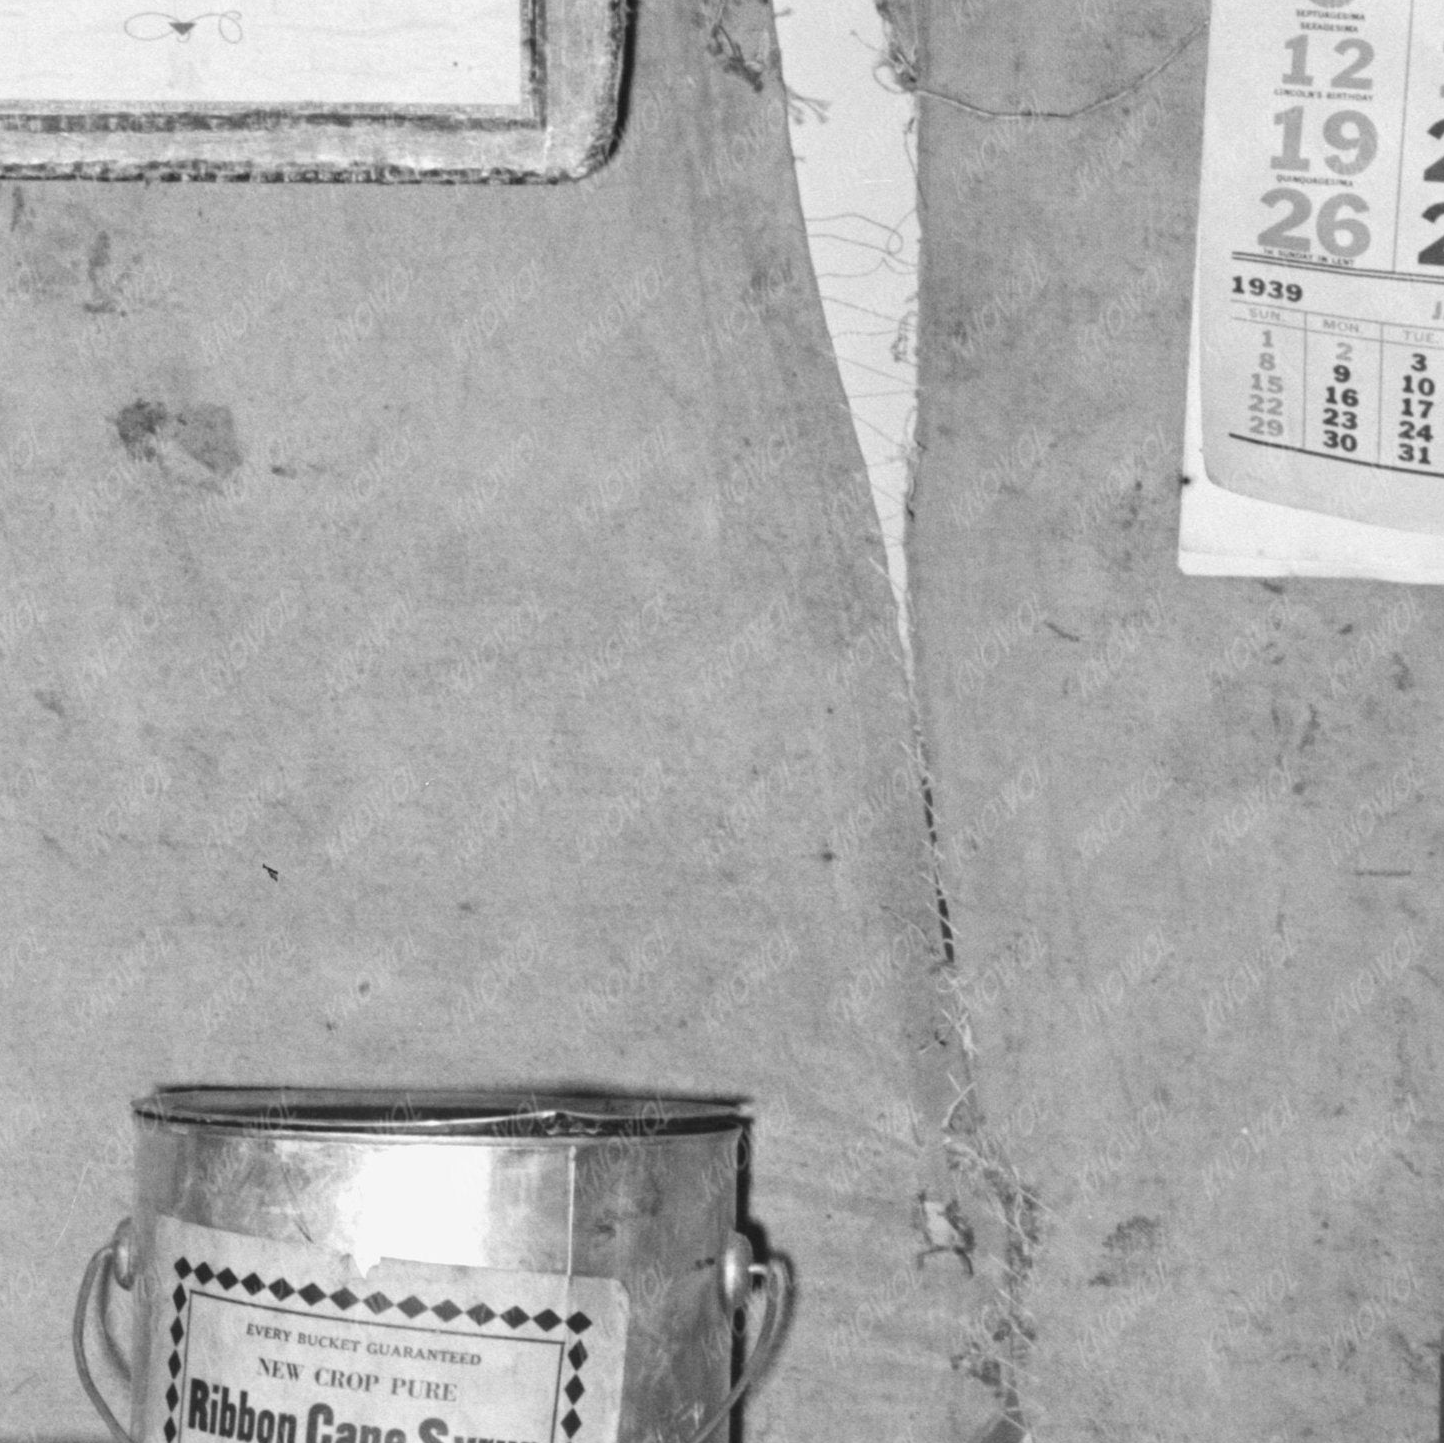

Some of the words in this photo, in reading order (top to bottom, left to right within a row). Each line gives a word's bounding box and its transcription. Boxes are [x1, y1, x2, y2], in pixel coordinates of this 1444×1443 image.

[1281, 34, 1376, 91] 12
[1269, 105, 1379, 177] 19
[1257, 186, 1372, 258] 26
[1229, 275, 1304, 303] 1939
[245, 1322, 292, 1343] EVERY
[297, 1332, 362, 1355] BUCKET
[366, 1341, 482, 1367] GUARANTEED
[256, 1356, 306, 1383] NEW
[314, 1366, 381, 1393] CROP
[390, 1376, 458, 1403] PURE
